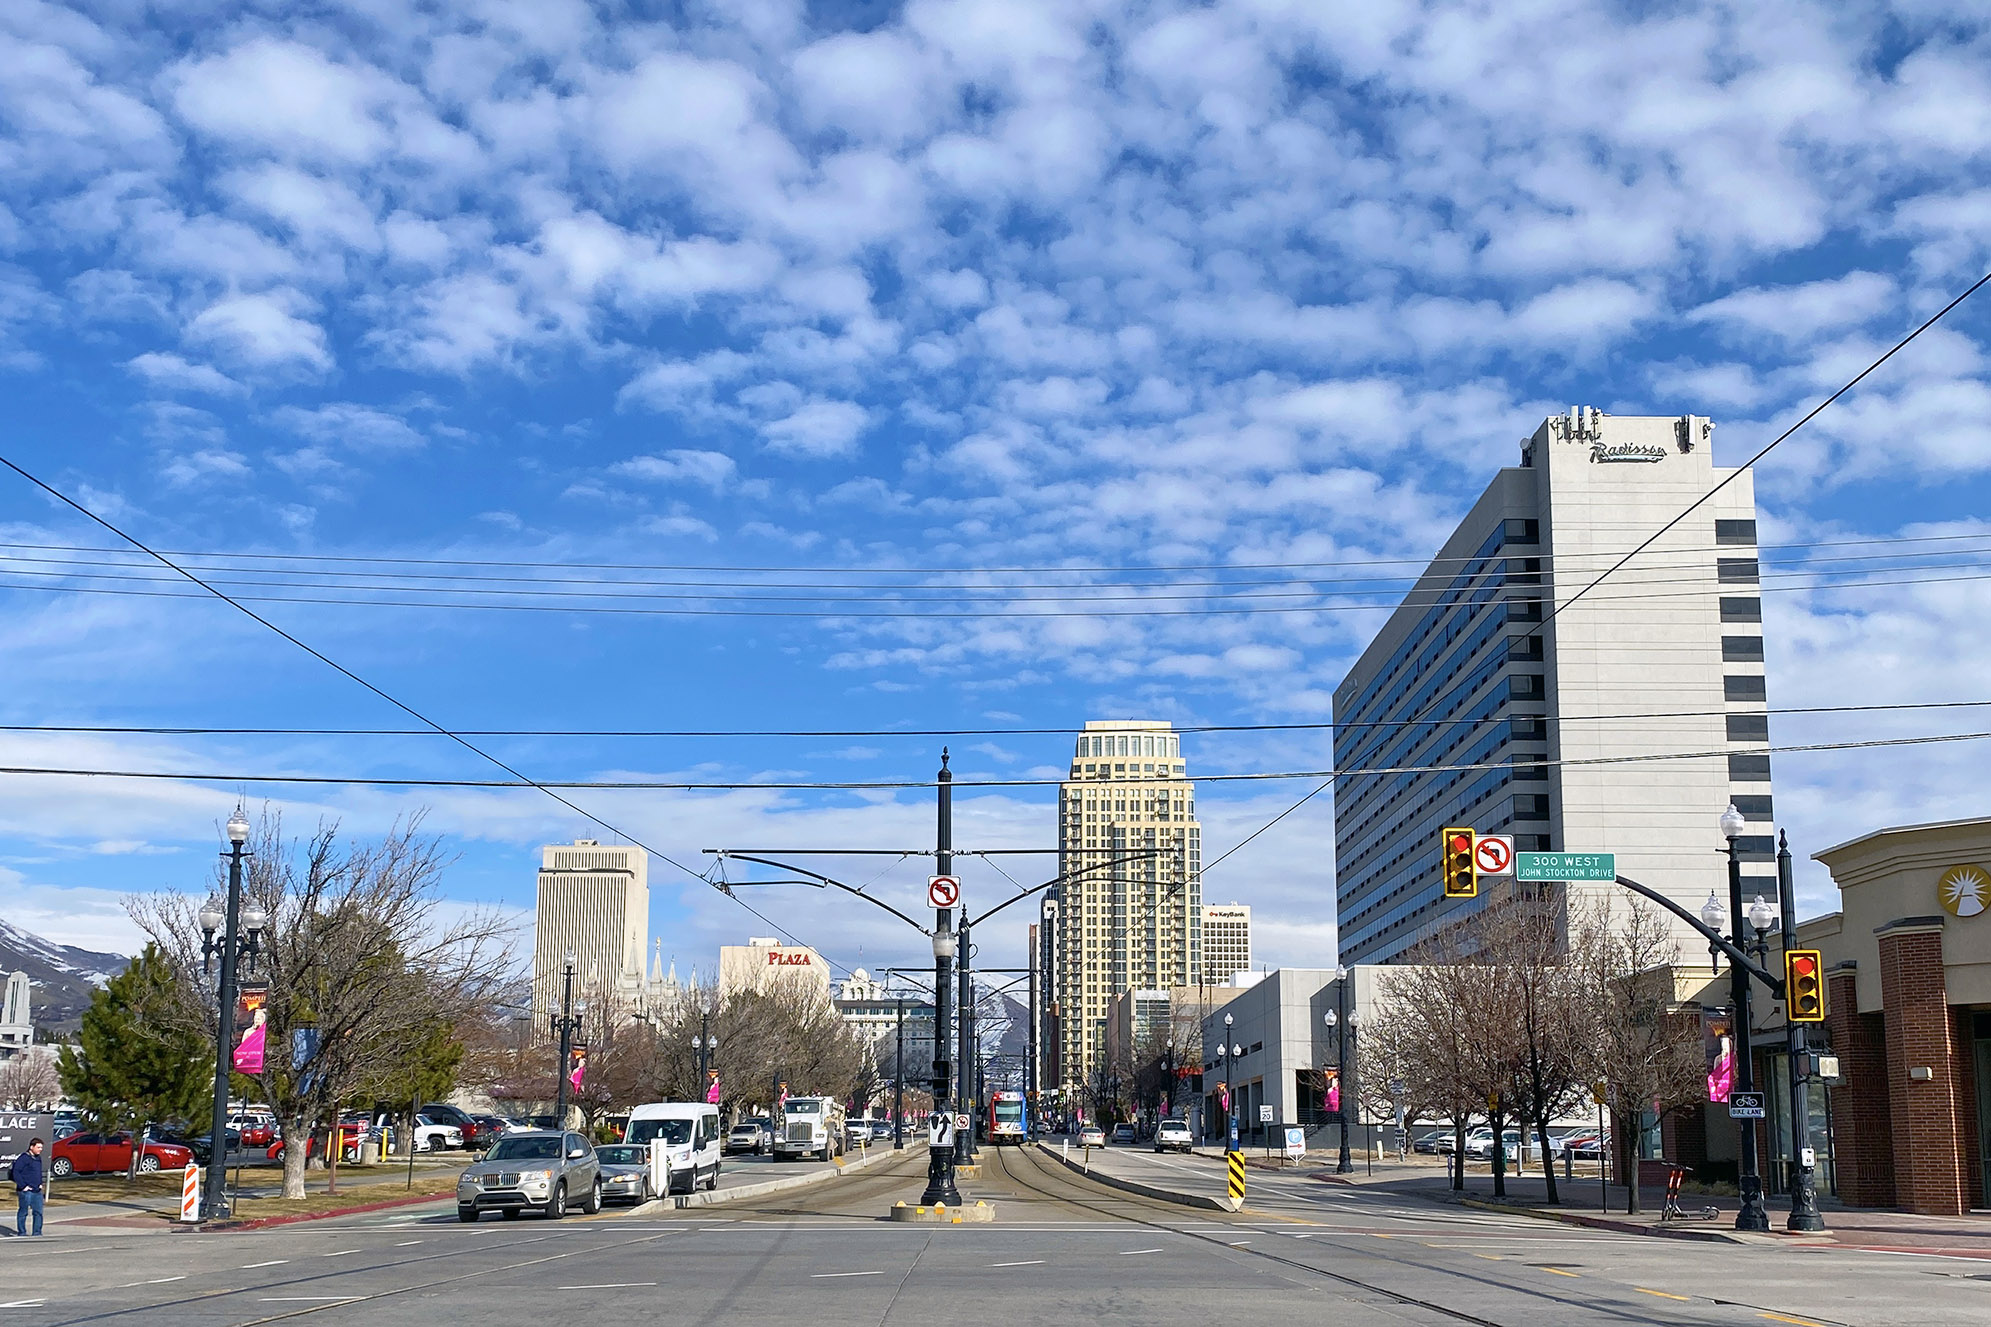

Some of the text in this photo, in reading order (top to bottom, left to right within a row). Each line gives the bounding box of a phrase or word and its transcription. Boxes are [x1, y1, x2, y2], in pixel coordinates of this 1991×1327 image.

[1589, 442, 1668, 464] Radisson
[1532, 856, 1601, 867] 300 WEST
[1520, 868, 1612, 878] JOHN STOCKTON DRIVE
[768, 952, 811, 965] PLAZA
